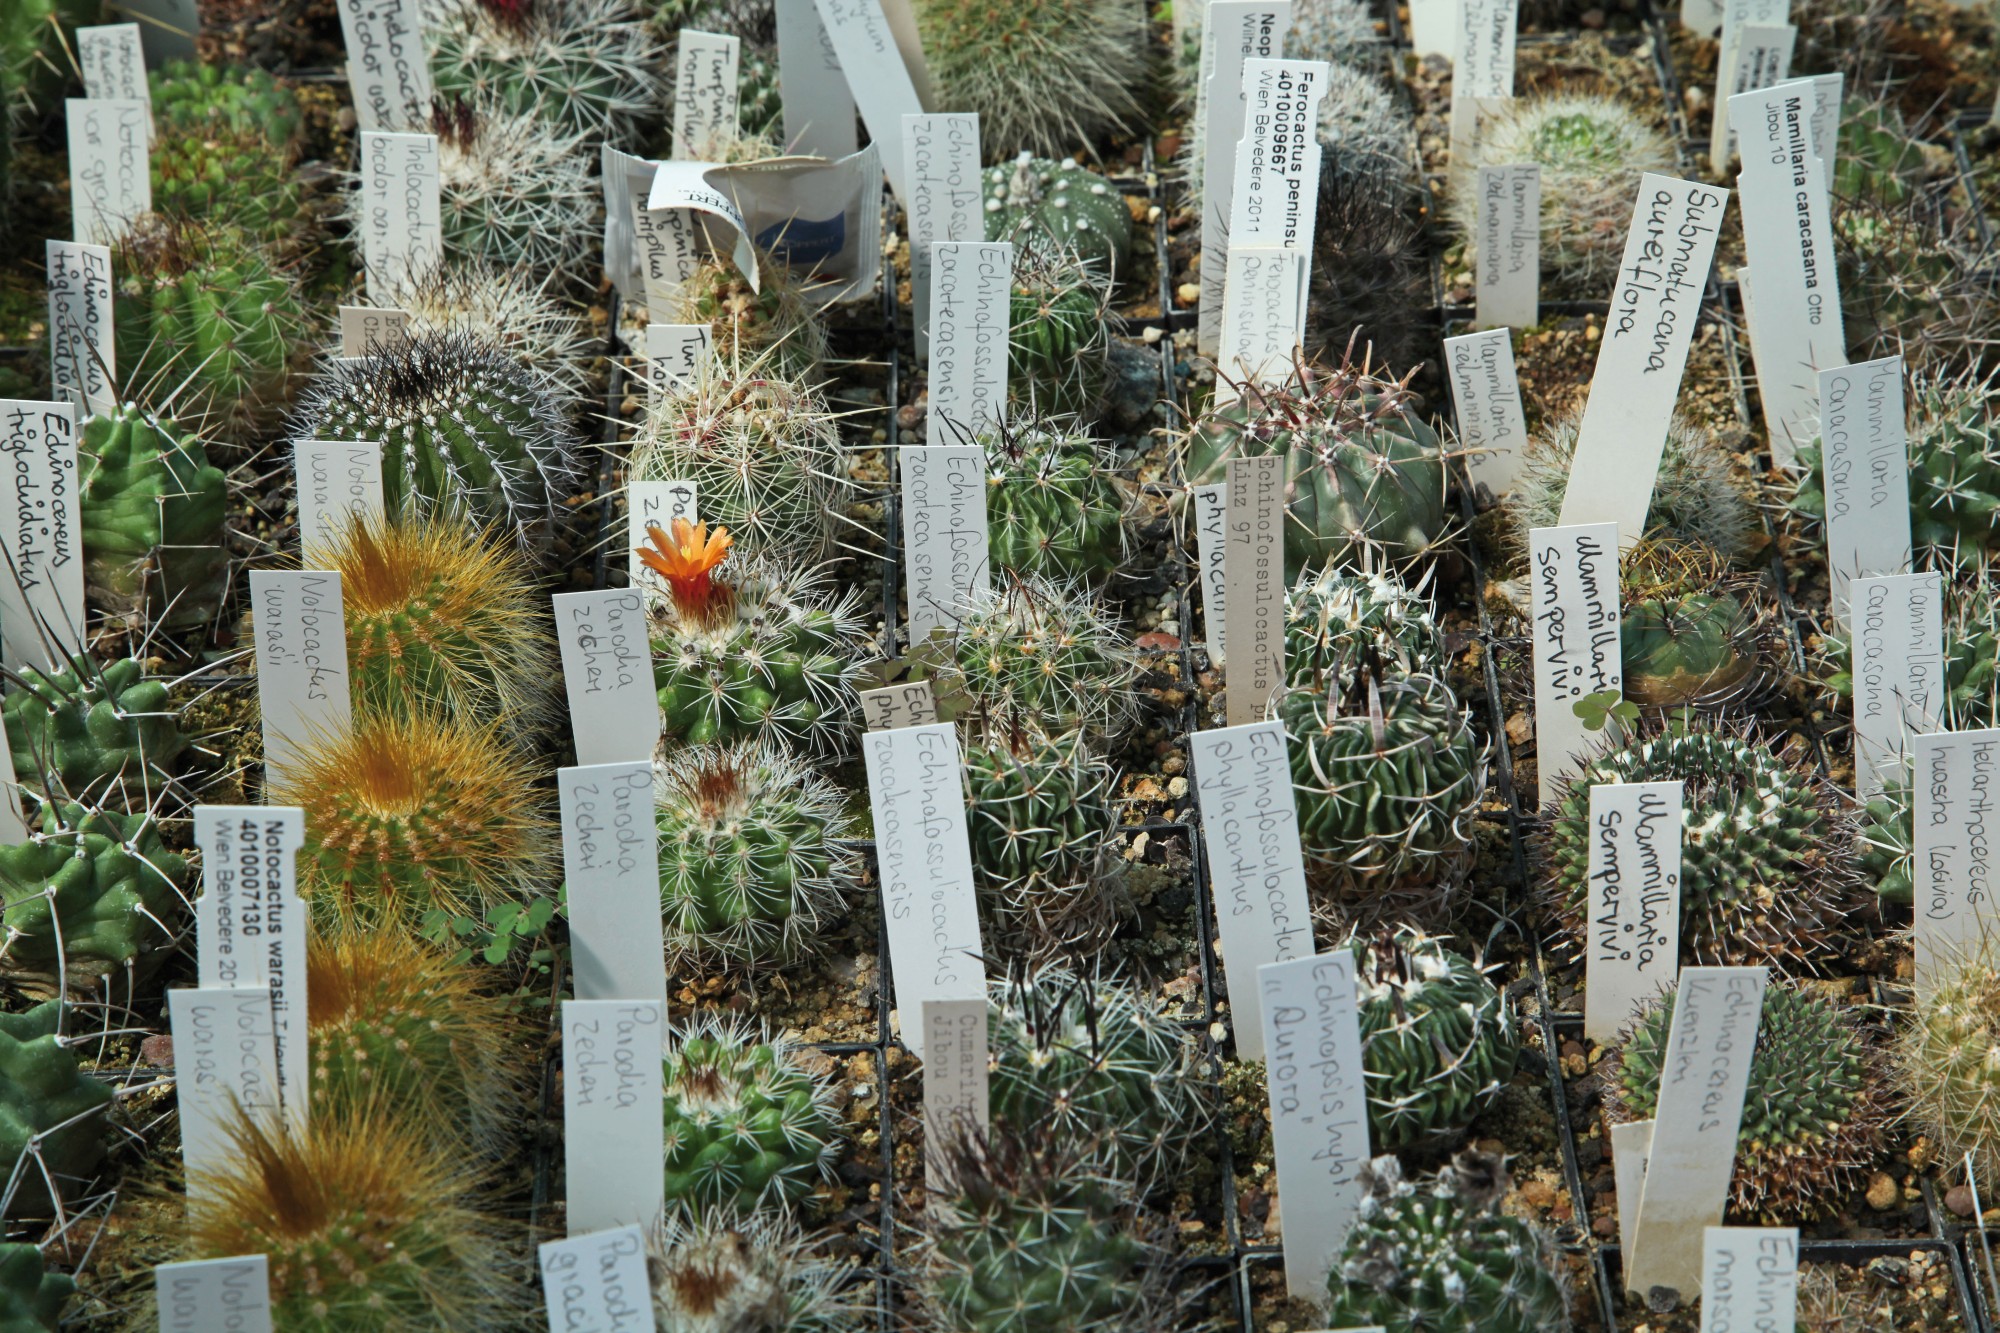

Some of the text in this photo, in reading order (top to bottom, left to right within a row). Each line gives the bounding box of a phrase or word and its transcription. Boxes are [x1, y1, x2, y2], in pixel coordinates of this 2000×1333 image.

[1256, 13, 1275, 59] Neop
[1271, 71, 1293, 176] 4010009667
[1284, 72, 1314, 249] Ferocactus peninsu
[1765, 102, 1786, 164] Jibou 10
[946, 117, 979, 242] Echinofossu
[1246, 197, 1263, 234] 2011
[1785, 97, 1823, 325] Mamillaria caracasana Otto
[1643, 188, 1719, 375] Submatucana
[1866, 360, 1898, 508] Mammillaria
[1232, 458, 1251, 544] Linz 97
[1256, 456, 1275, 689] Echinofossulocactus
[1576, 536, 1618, 693] Mammillari
[300, 577, 342, 701] Notocactus
[605, 595, 641, 689] Parodia
[1907, 576, 1939, 708] Mammillaria
[612, 770, 653, 877] Parodia
[1930, 746, 1955, 826] huascha
[1965, 741, 1994, 904] Helianthocereus
[240, 819, 261, 937] 4010007130
[265, 820, 285, 934] Notocactus
[1635, 793, 1677, 972] Mammillaria
[267, 941, 290, 1012] warasii
[615, 1005, 659, 1110] Parodia
[934, 1014, 954, 1080] Jibou
[546, 1252, 599, 1333] graci
[598, 1233, 641, 1333] Parodi
[1755, 1235, 1798, 1333] Echino
